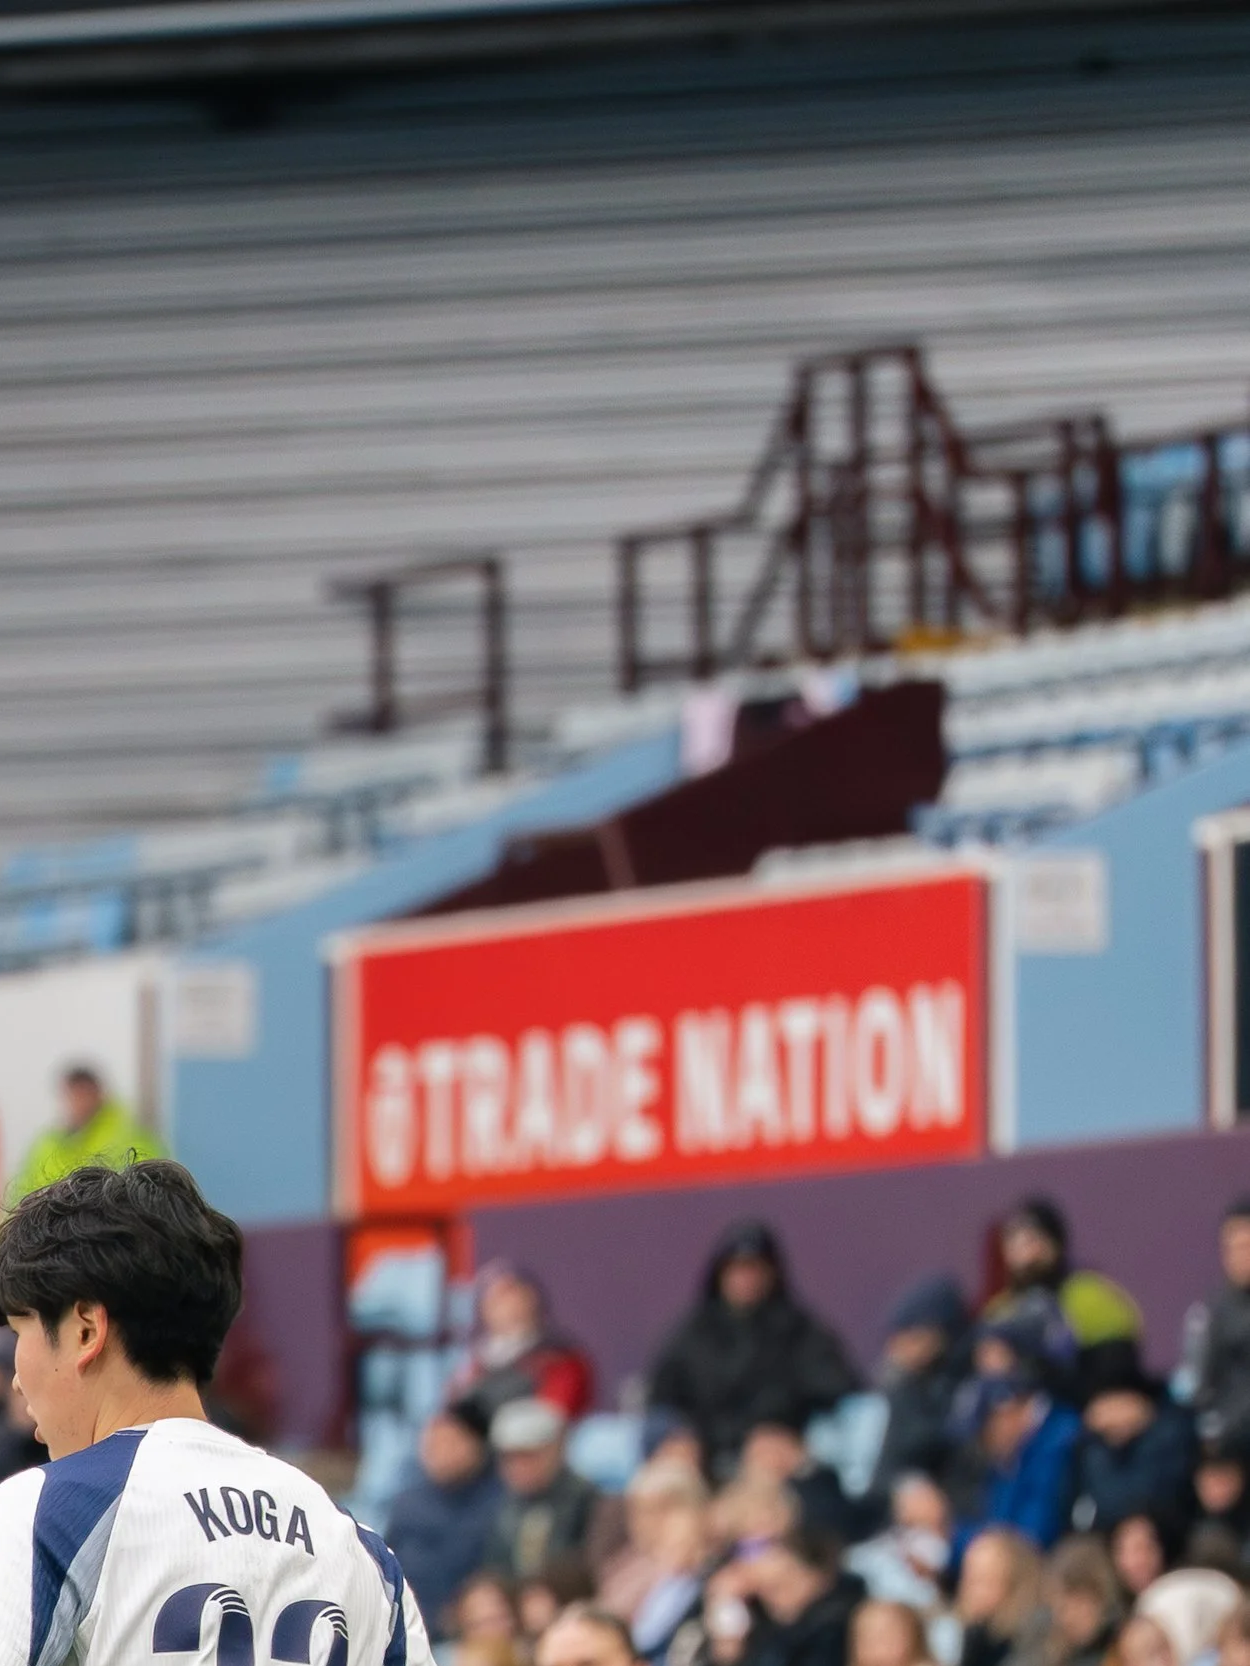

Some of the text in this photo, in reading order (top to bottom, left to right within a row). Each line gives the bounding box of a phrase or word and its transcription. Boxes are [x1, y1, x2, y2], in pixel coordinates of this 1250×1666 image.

[417, 978, 966, 1182] TRADE NATION
[183, 1485, 316, 1557] KOGA
